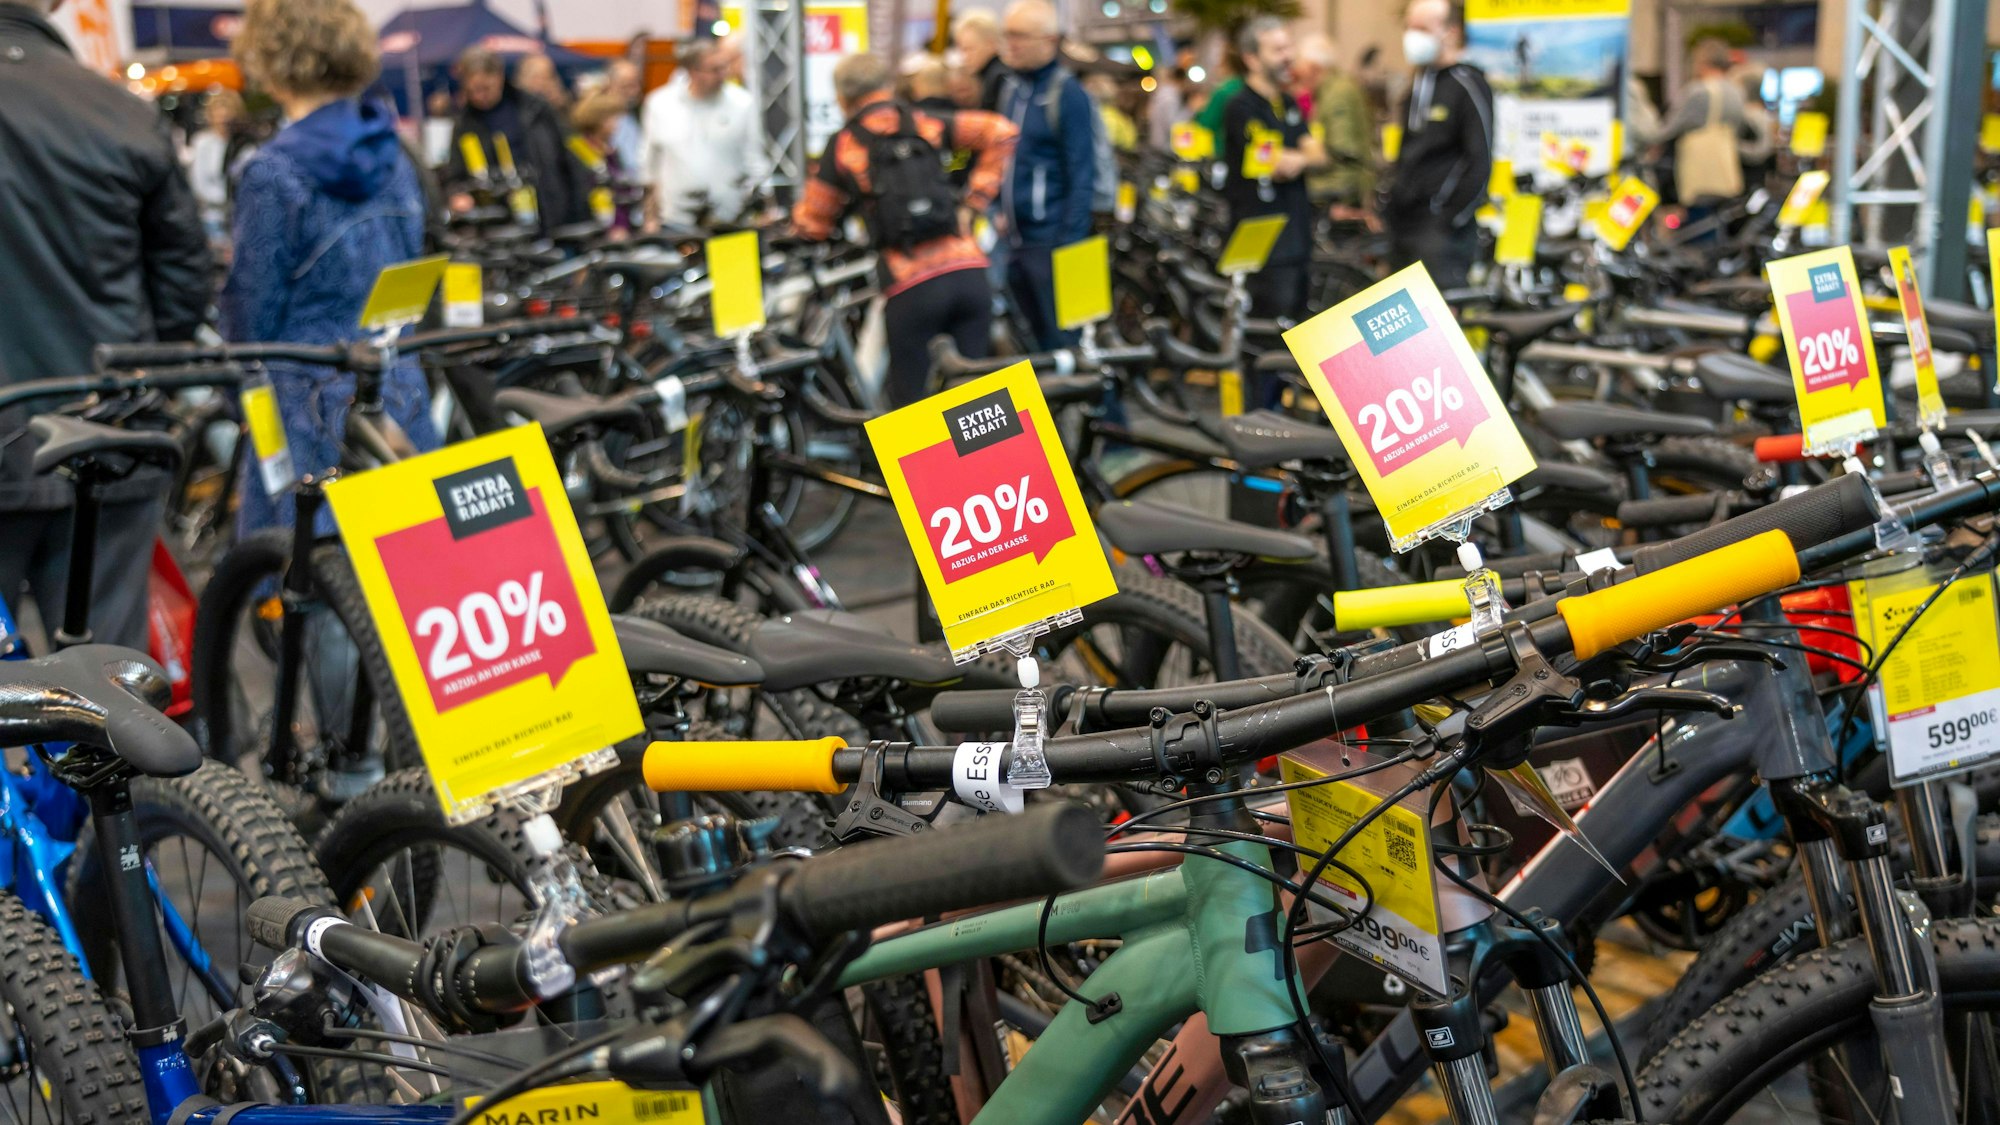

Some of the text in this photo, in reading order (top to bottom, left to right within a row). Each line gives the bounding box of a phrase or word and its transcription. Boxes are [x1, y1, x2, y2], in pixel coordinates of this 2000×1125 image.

[1366, 303, 1408, 331] EXTRA
[1373, 314, 1413, 341] RABATT
[1800, 326, 1859, 376] 20%
[958, 403, 1005, 431] EXTRA
[962, 416, 1008, 441] RABATT
[1358, 366, 1464, 454] 20%
[1383, 422, 1451, 463] ABZUG AN DER KASSE
[449, 473, 512, 507] EXTRA
[456, 490, 516, 522] RABATT
[1396, 462, 1480, 512] EINFACH DAS RICHTIGE RAD
[930, 474, 1049, 560] 20%
[951, 534, 1029, 571] ABZUG AN DER KASSE
[958, 579, 1056, 621] EINFACH DAS RICHTIGE RAD
[415, 570, 567, 680] 20%
[443, 650, 543, 696] ABZUG AN DER KASSE
[454, 711, 574, 766] EINFACH DAS RICHTIGE RAD
[485, 1102, 600, 1125] MARIN
